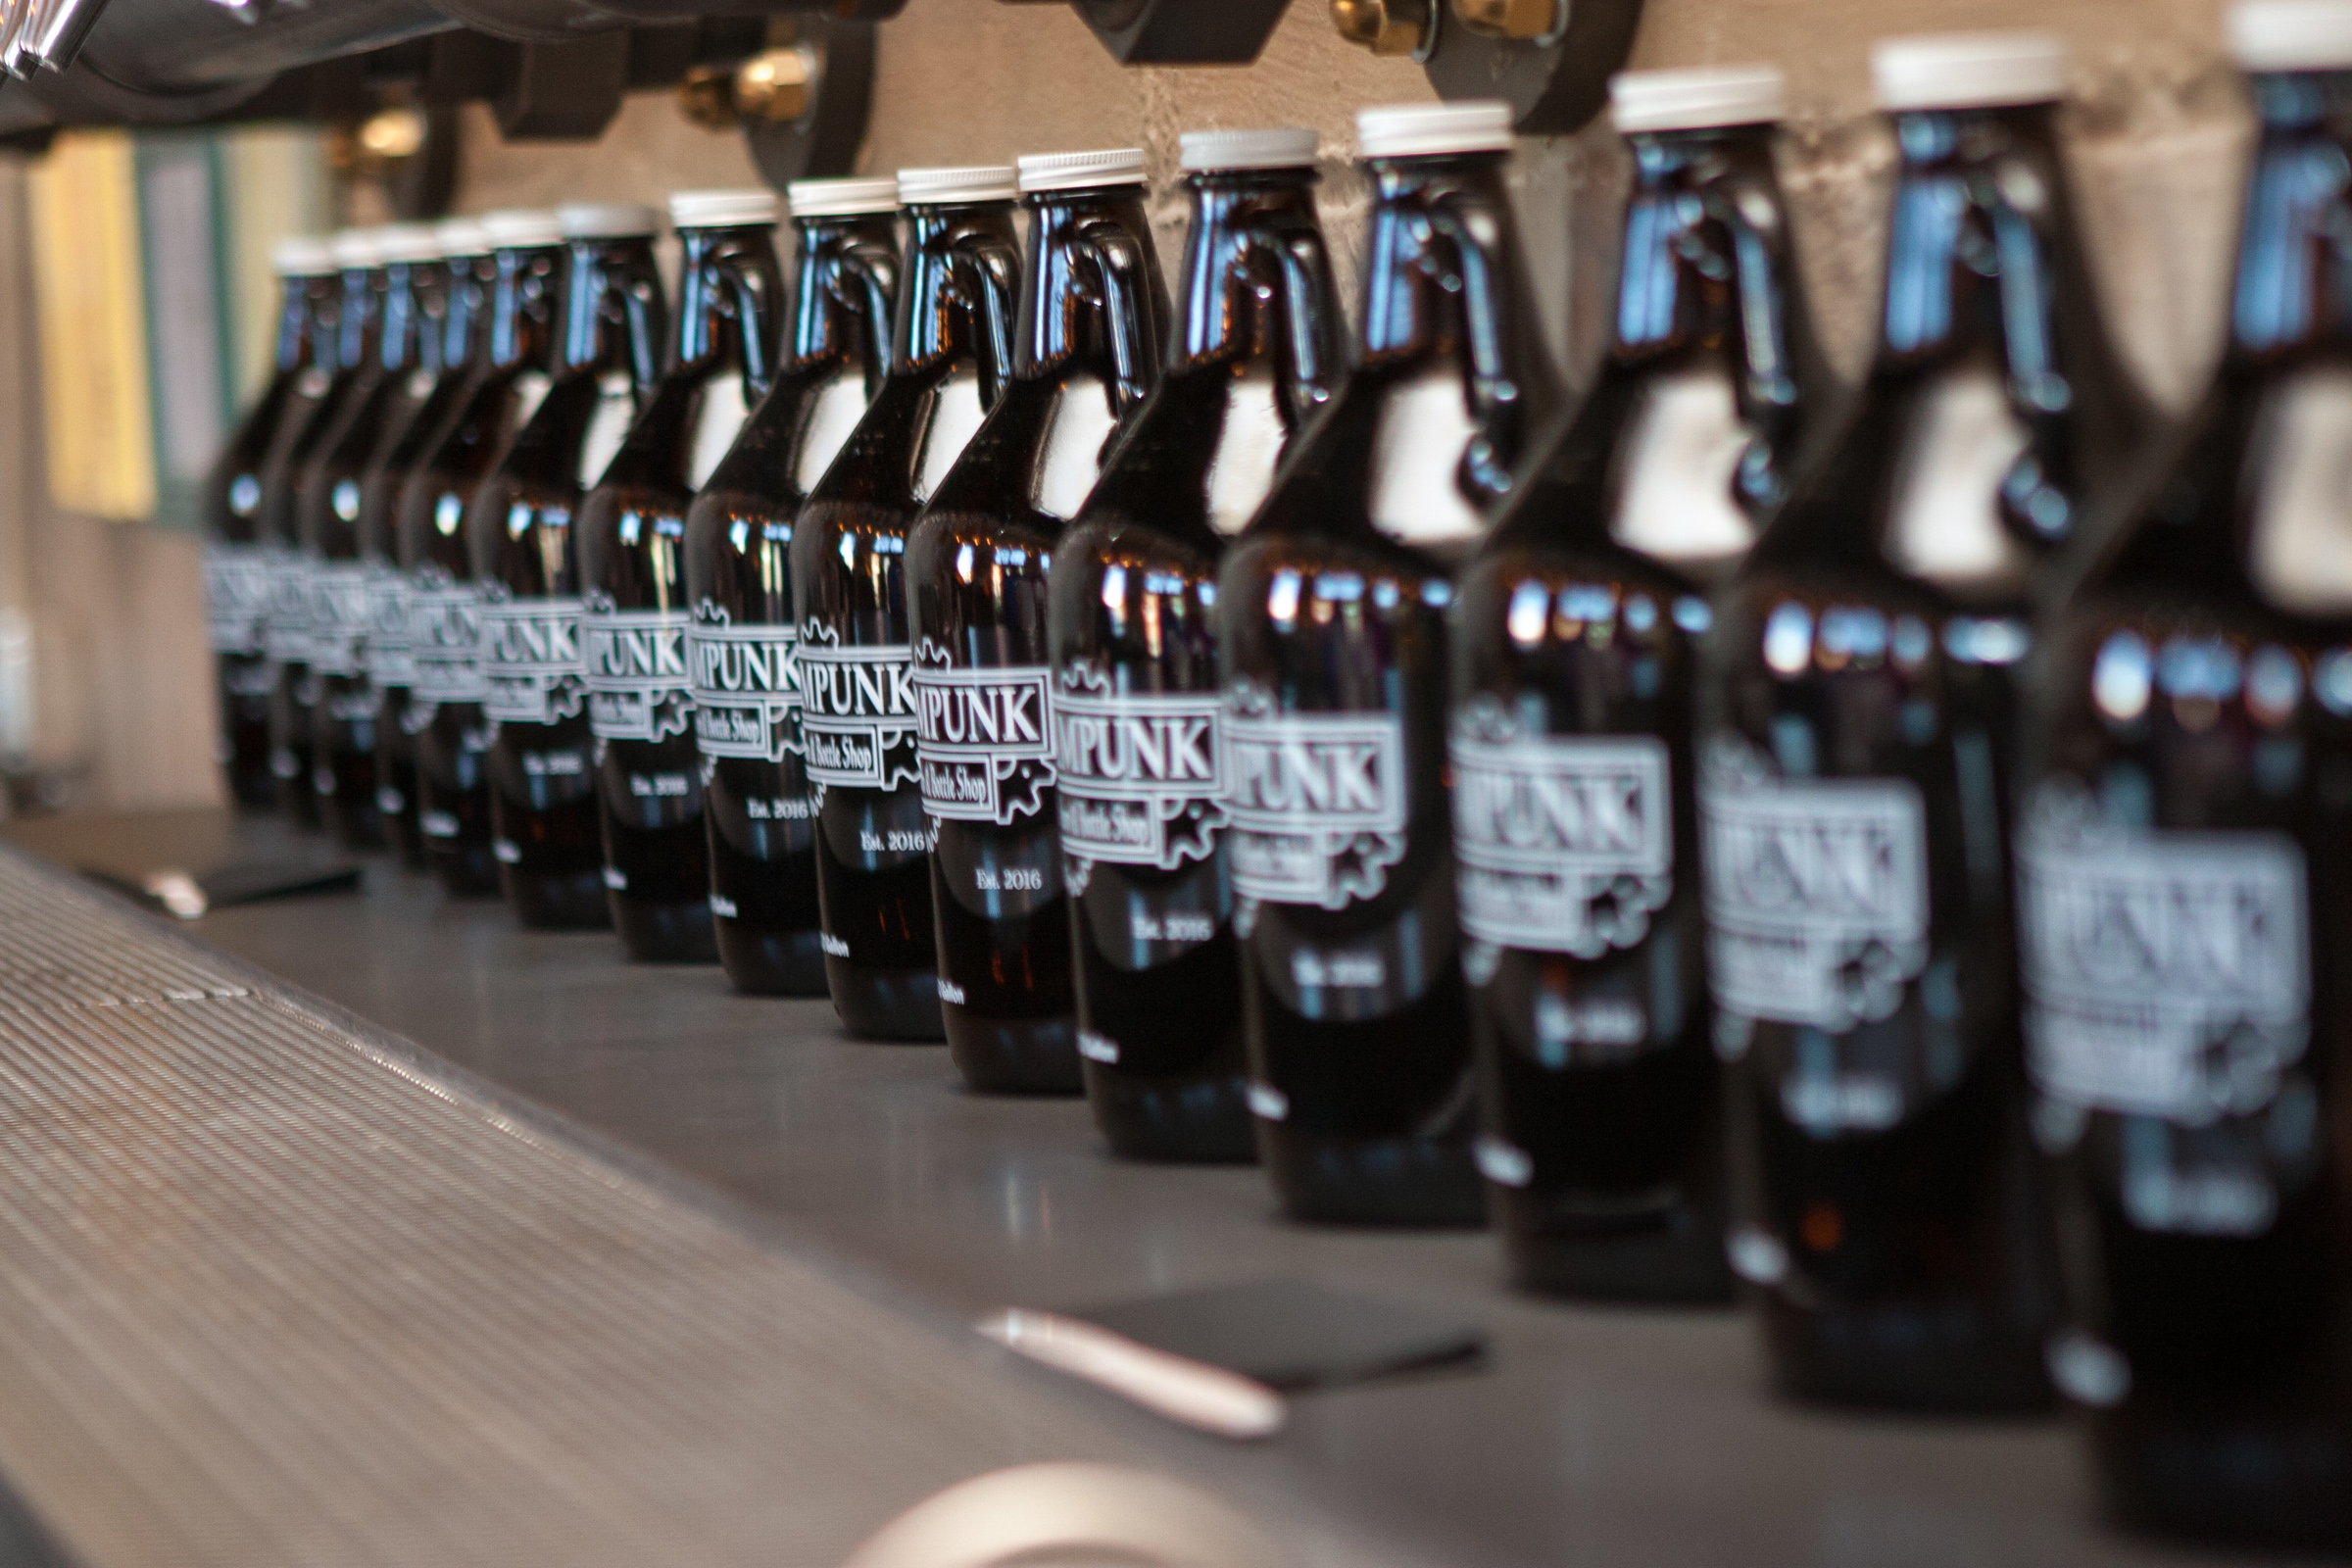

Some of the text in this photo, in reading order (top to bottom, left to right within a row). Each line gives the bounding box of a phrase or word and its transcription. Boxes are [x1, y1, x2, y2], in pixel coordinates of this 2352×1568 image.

[842, 735, 872, 776] Shop
[956, 764, 987, 808] Shop
[773, 797, 808, 819] 2016
[887, 829, 925, 852] 2016
[1004, 867, 1042, 890] 2016
